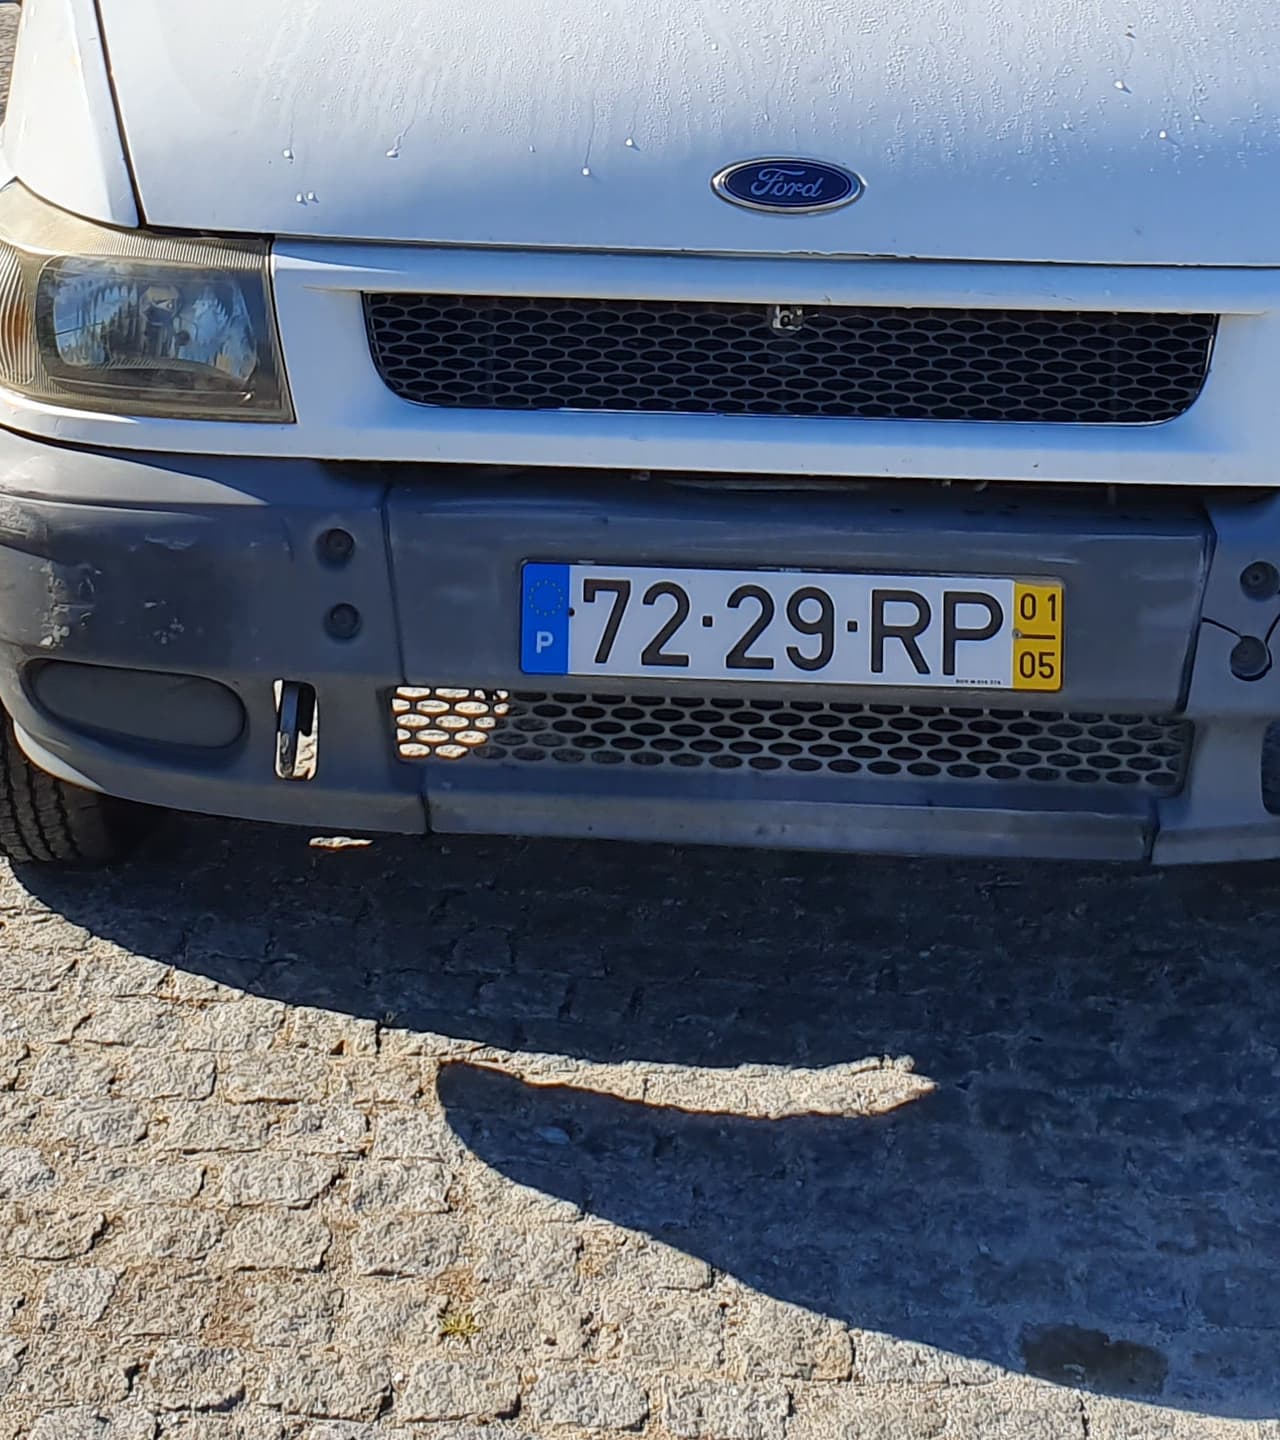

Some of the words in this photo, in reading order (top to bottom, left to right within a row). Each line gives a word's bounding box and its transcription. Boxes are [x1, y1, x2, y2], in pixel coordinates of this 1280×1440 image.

[750, 168, 823, 197] Ford
[536, 632, 553, 653] P
[1019, 651, 1056, 680] 05
